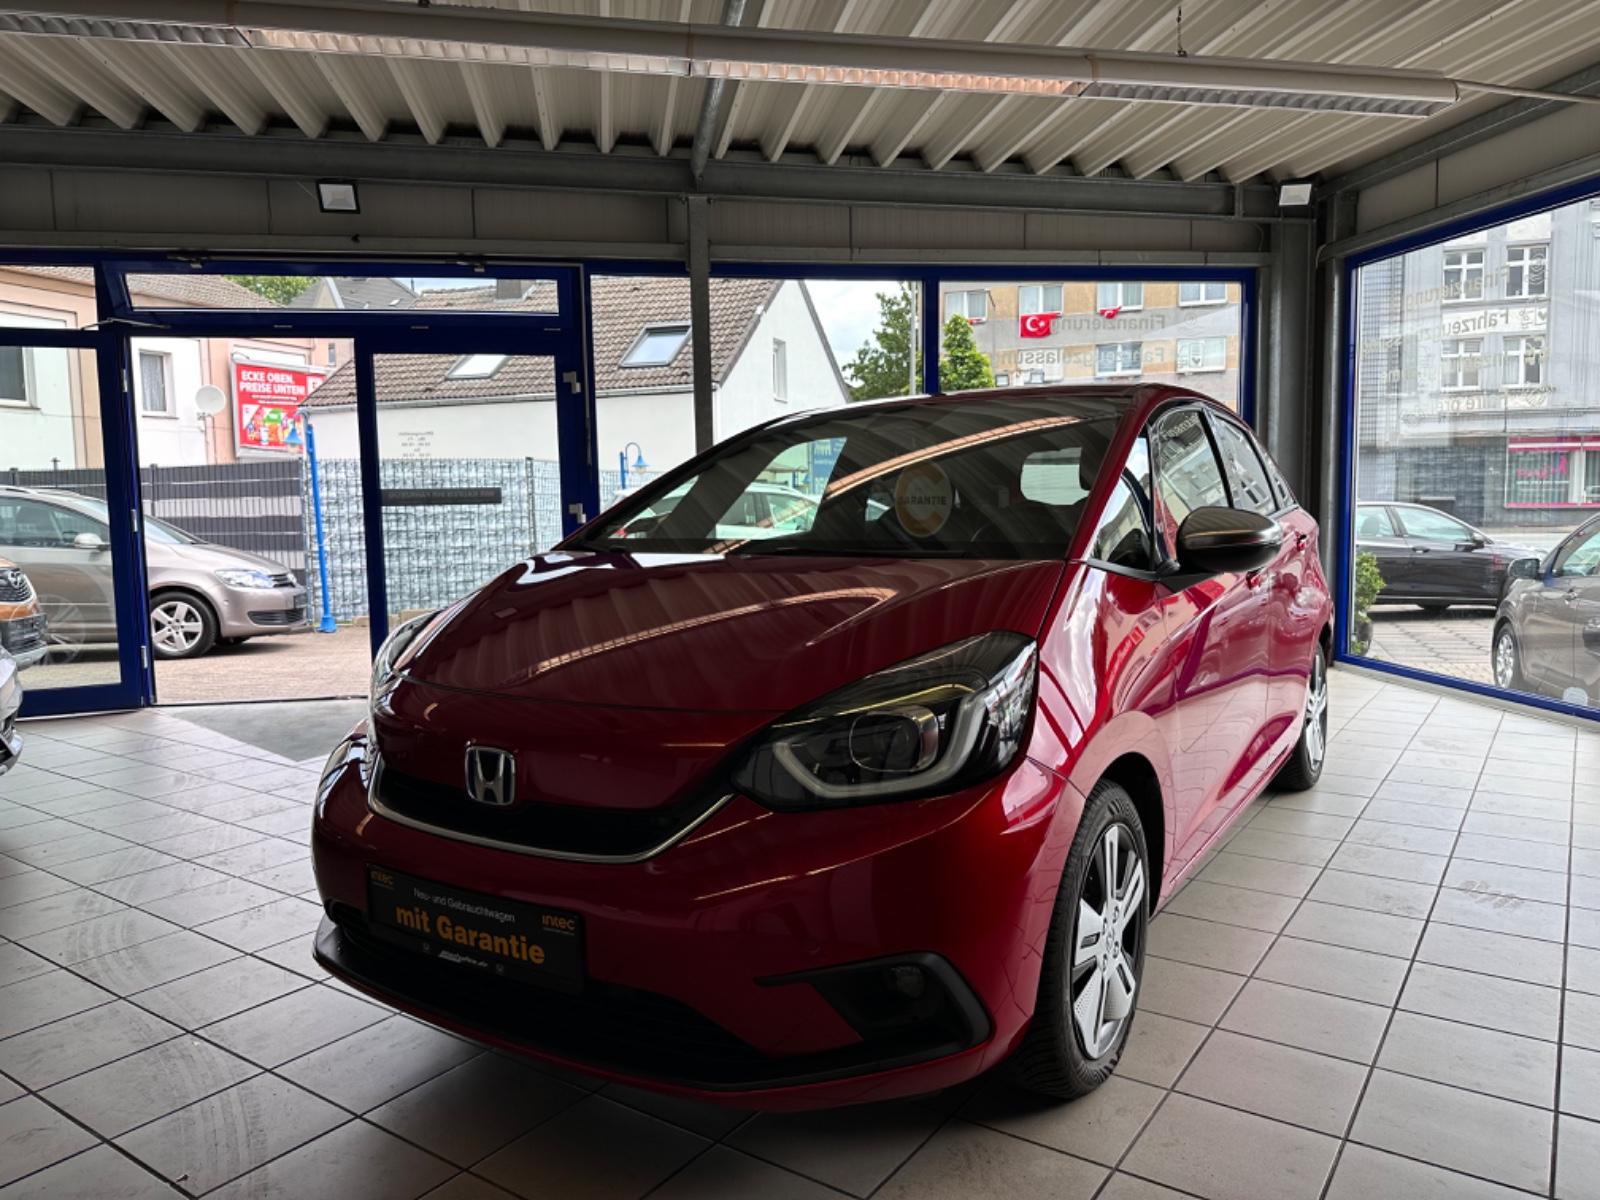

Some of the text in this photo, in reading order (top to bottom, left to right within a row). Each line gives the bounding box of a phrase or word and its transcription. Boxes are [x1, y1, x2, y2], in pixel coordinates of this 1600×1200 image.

[241, 370, 265, 382] ECKE
[240, 381, 272, 393] PREISE
[395, 904, 431, 933] mit
[436, 915, 545, 965] Garantie
